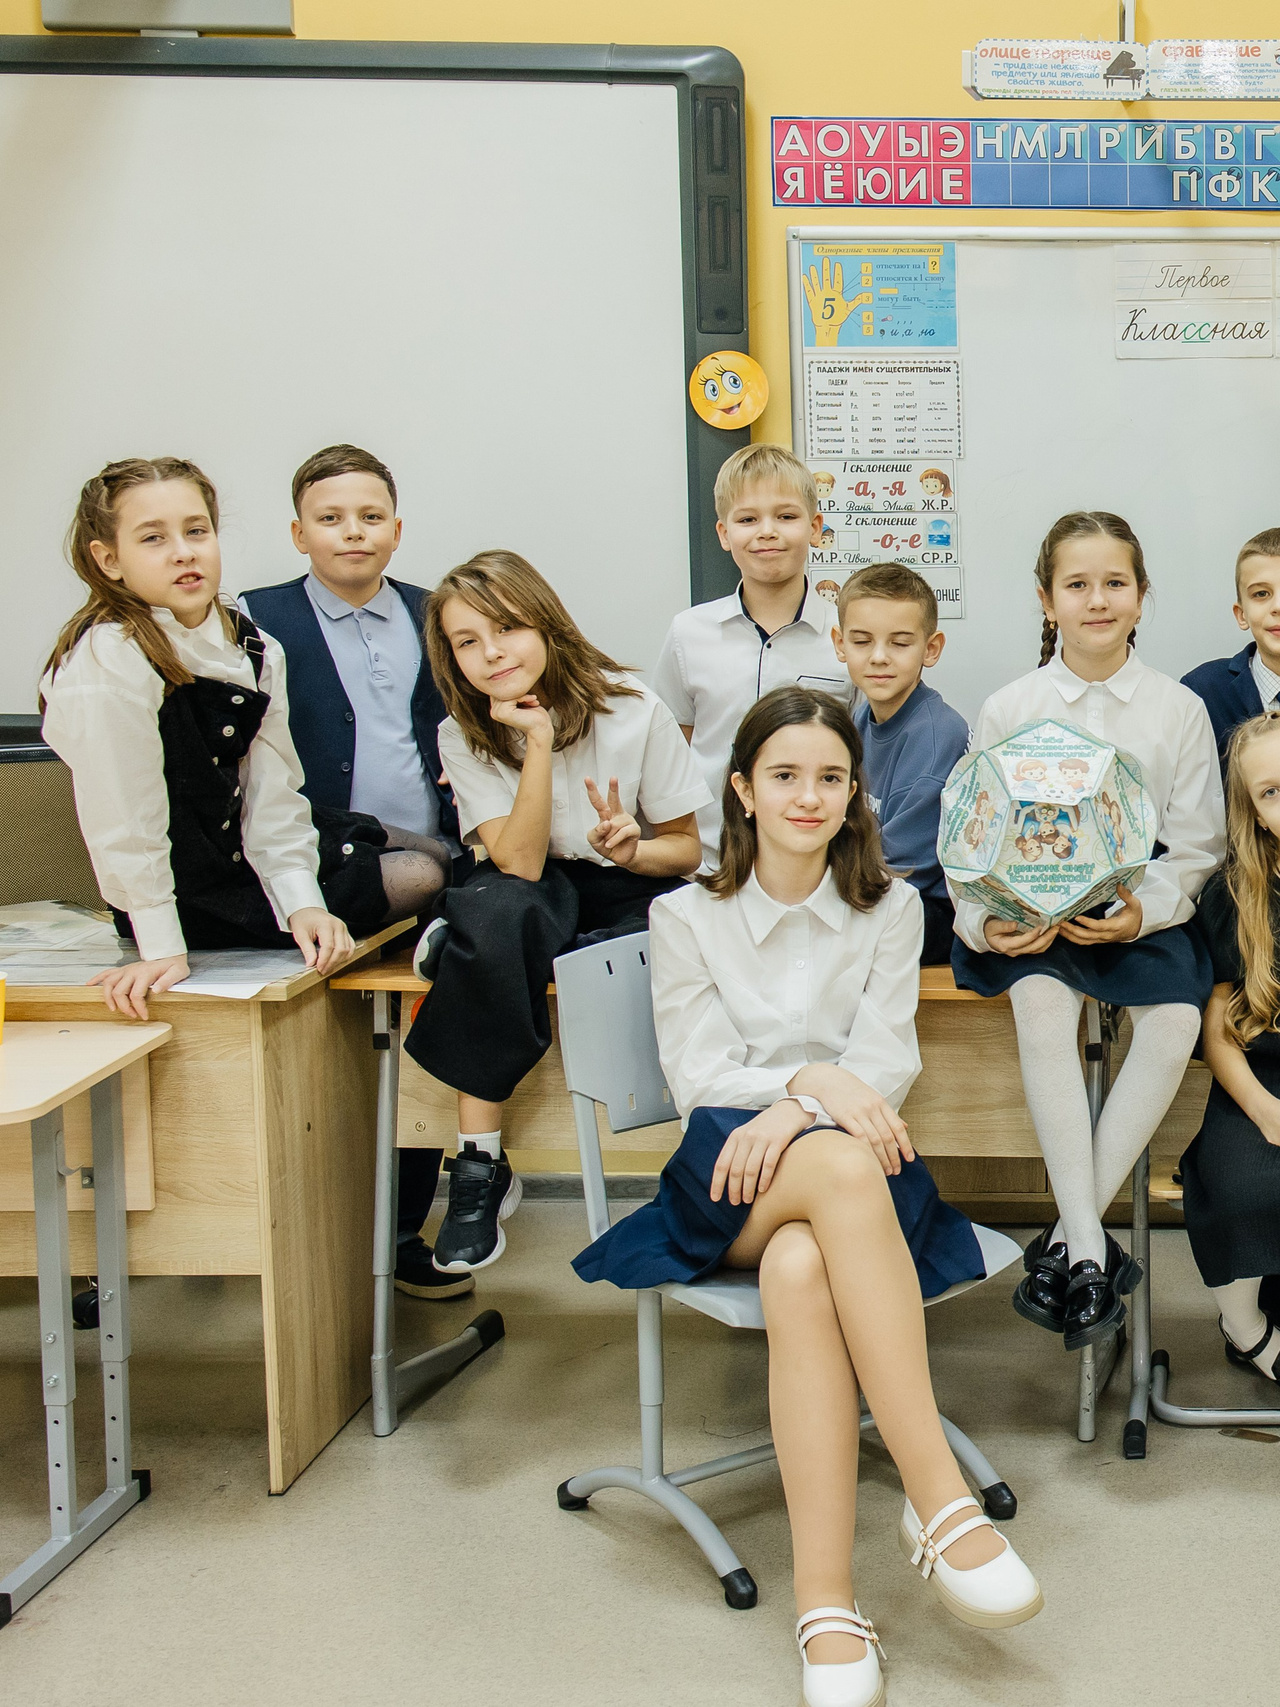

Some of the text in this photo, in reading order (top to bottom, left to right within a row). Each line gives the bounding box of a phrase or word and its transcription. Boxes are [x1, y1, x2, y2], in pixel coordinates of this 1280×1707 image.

[777, 124, 809, 156] А
[816, 124, 851, 157] О
[857, 125, 887, 158] У
[898, 125, 929, 157] Ы
[939, 125, 965, 157] Э
[975, 126, 1003, 158] Н
[1011, 126, 1046, 159] М
[1054, 126, 1082, 159] Л
[1099, 126, 1121, 159] Р
[1134, 124, 1163, 160] Й
[1174, 129, 1197, 160] Б
[1214, 129, 1236, 160] В
[1254, 129, 1277, 161] Г
[782, 167, 805, 198] Я
[823, 163, 845, 199] Ё
[857, 168, 892, 200] Ю
[898, 168, 927, 200] И
[942, 168, 964, 200] Е
[1171, 170, 1198, 202] П
[1207, 170, 1240, 202] Ф
[1253, 171, 1279, 203] К
[816, 246, 863, 255] Однородные
[892, 247, 941, 255] предложения
[925, 275, 945, 283] слову
[1154, 264, 1231, 298] Первое
[877, 296, 898, 304] могут
[821, 297, 836, 320] 5
[1121, 308, 1271, 342] Классная
[816, 366, 850, 374] ПАДЕЖИ
[876, 365, 951, 374] СУЩЕСТВИТЕЛЬНЫХ
[843, 462, 913, 473] 1 склонение
[846, 499, 953, 511] Ваня Мила Ж.Р.
[845, 514, 918, 526] 2 склонение
[811, 552, 957, 564] М.Р. Иван окно СР.Р.
